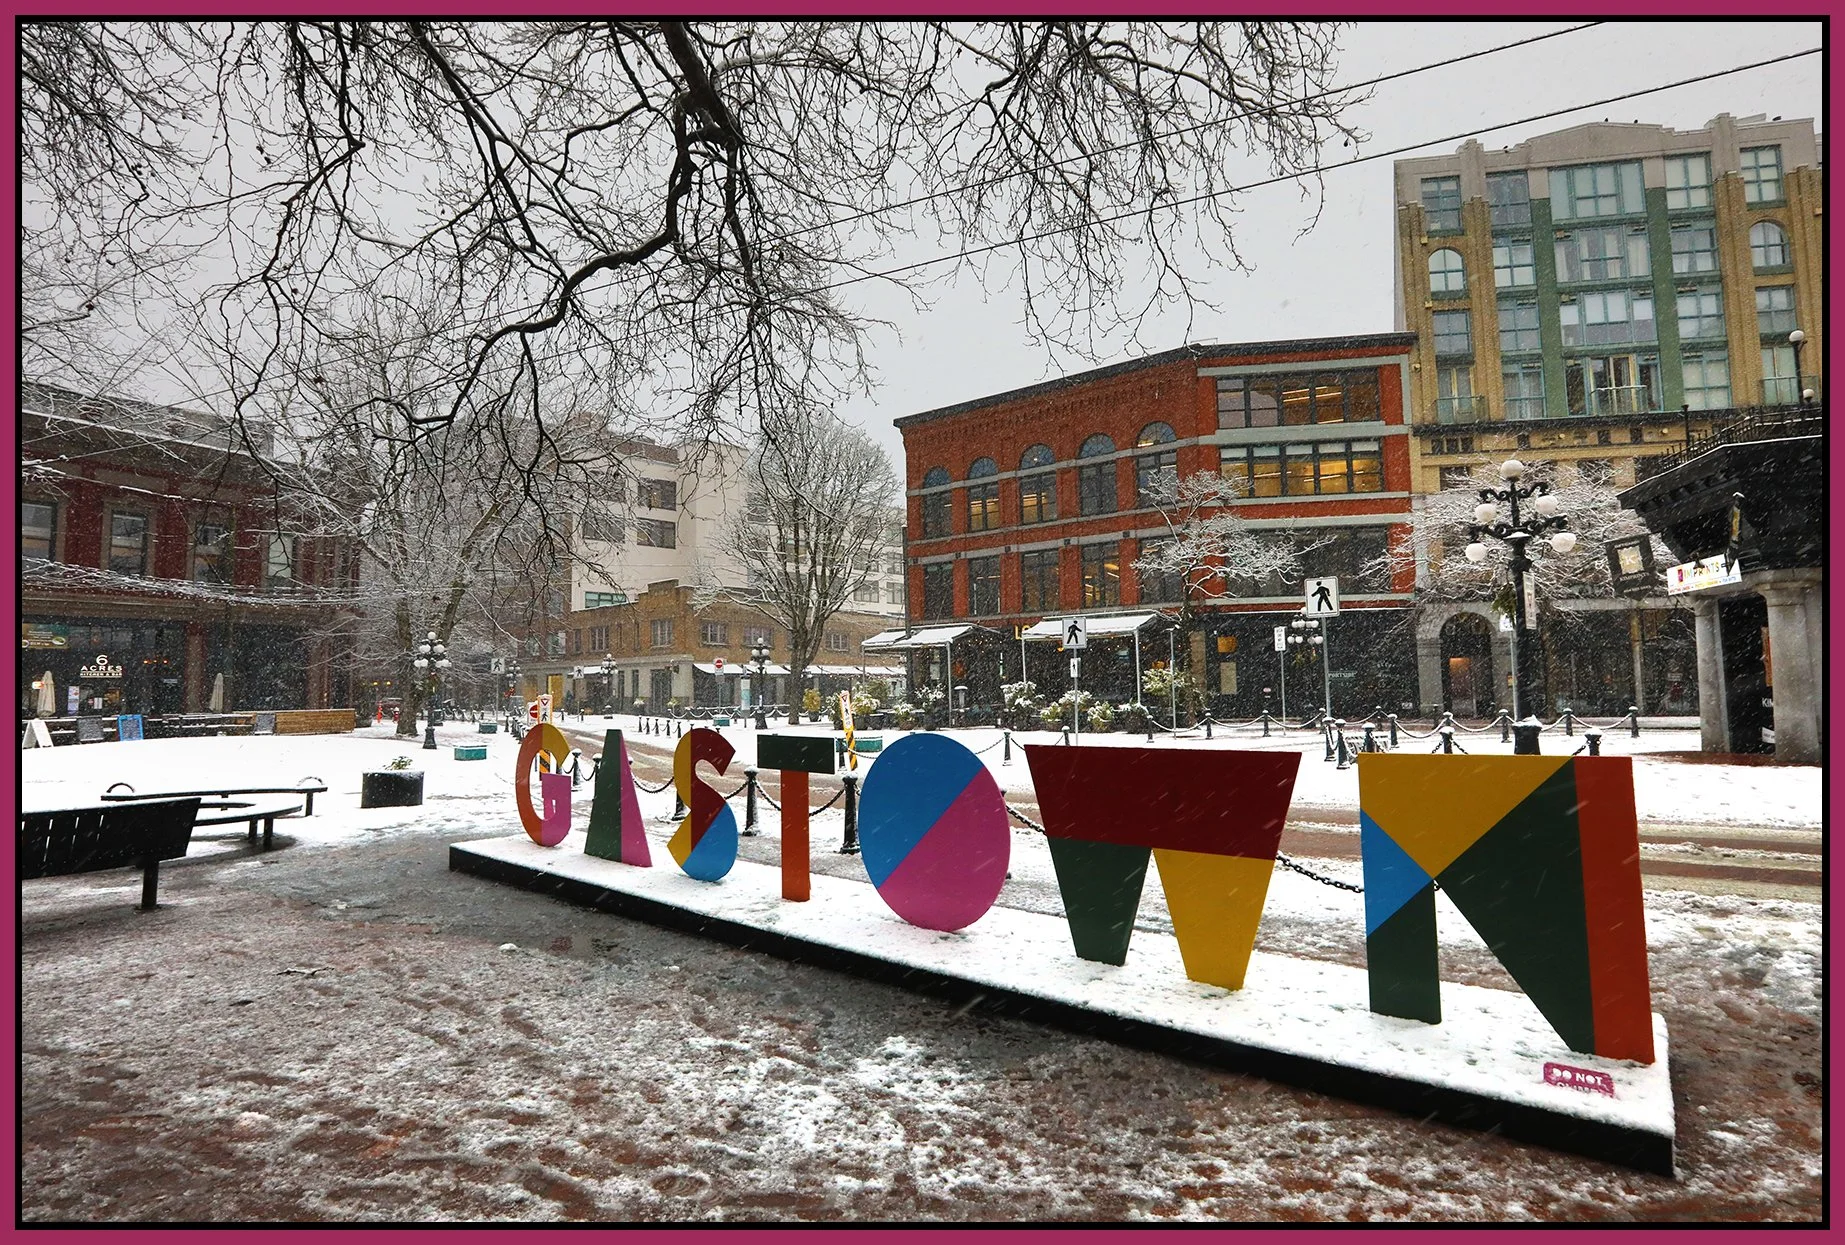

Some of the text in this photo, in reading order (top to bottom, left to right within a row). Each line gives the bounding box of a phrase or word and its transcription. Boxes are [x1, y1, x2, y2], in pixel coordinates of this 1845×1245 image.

[96, 654, 109, 666] 6
[515, 721, 1656, 1065] GASTOWN
[1552, 1067, 1603, 1086] DO NOT
